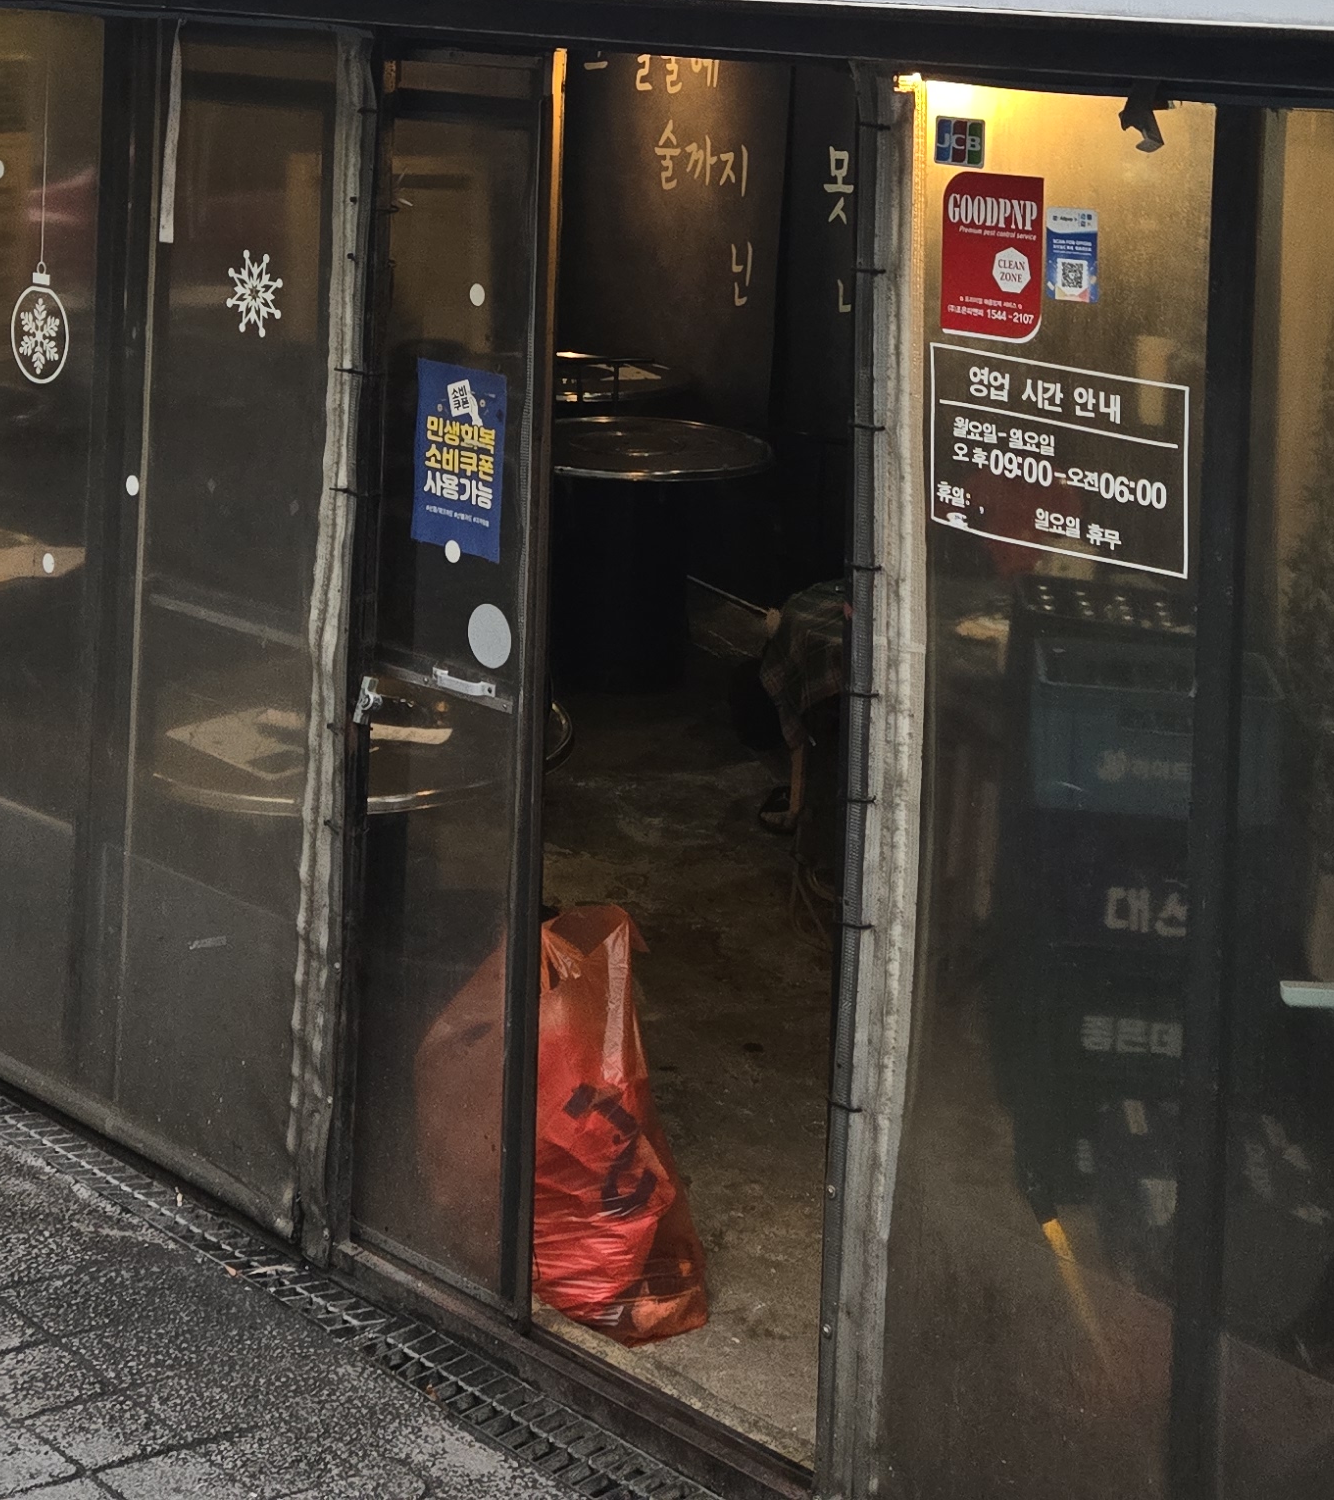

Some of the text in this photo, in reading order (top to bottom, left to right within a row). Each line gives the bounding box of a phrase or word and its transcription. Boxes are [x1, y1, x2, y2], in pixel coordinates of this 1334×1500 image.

[655, 120, 747, 197] 술까지
[937, 133, 980, 151] JCB
[948, 193, 1037, 230] GOODPNP
[997, 258, 1026, 271] CLEAN
[999, 271, 1023, 283] ZONE
[451, 385, 467, 399] 소비
[969, 366, 1120, 425] 영업 시간 안내
[426, 415, 496, 454] 민생회복
[425, 444, 494, 482] 소비쿠폰
[424, 470, 493, 510] 사용가능
[1086, 523, 1122, 551] 휴무
